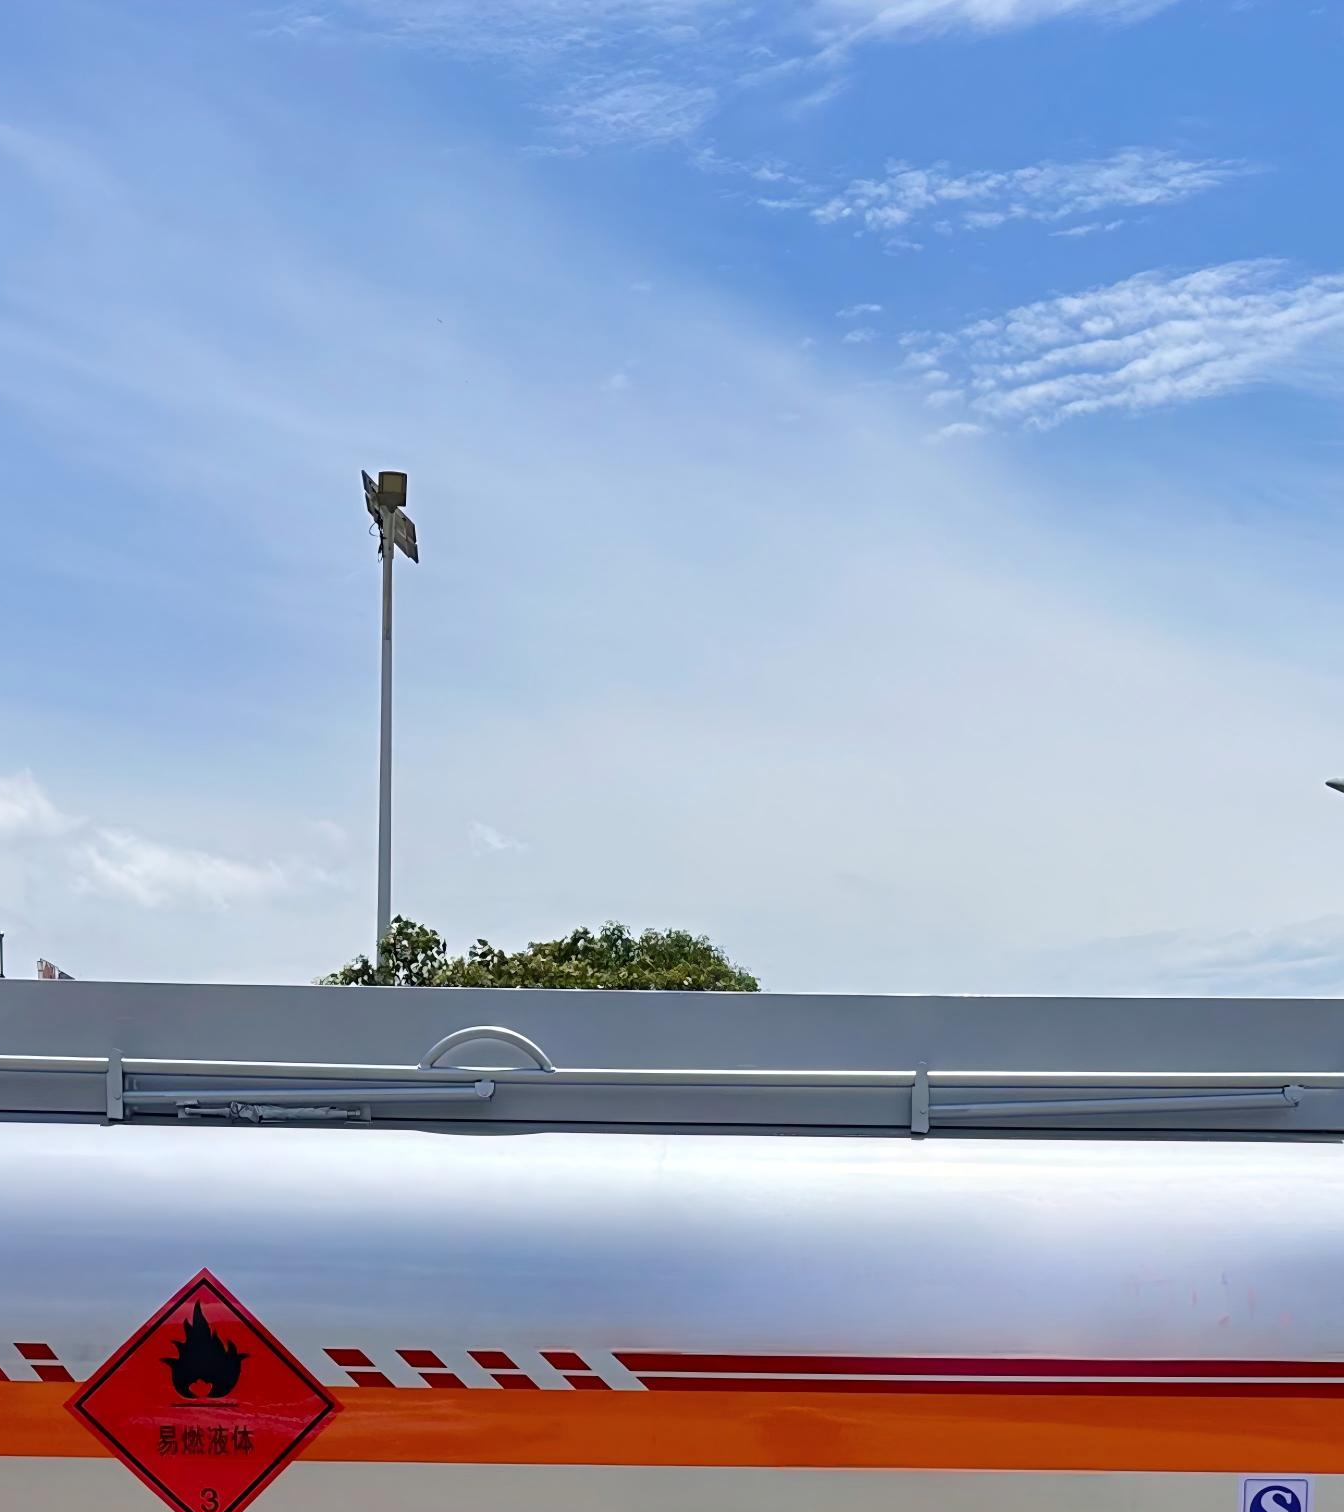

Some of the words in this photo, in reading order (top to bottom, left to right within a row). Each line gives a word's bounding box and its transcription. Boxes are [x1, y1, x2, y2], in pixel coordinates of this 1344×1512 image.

[159, 1426, 256, 1455] 易燃液体
[200, 1488, 219, 1512] 3
